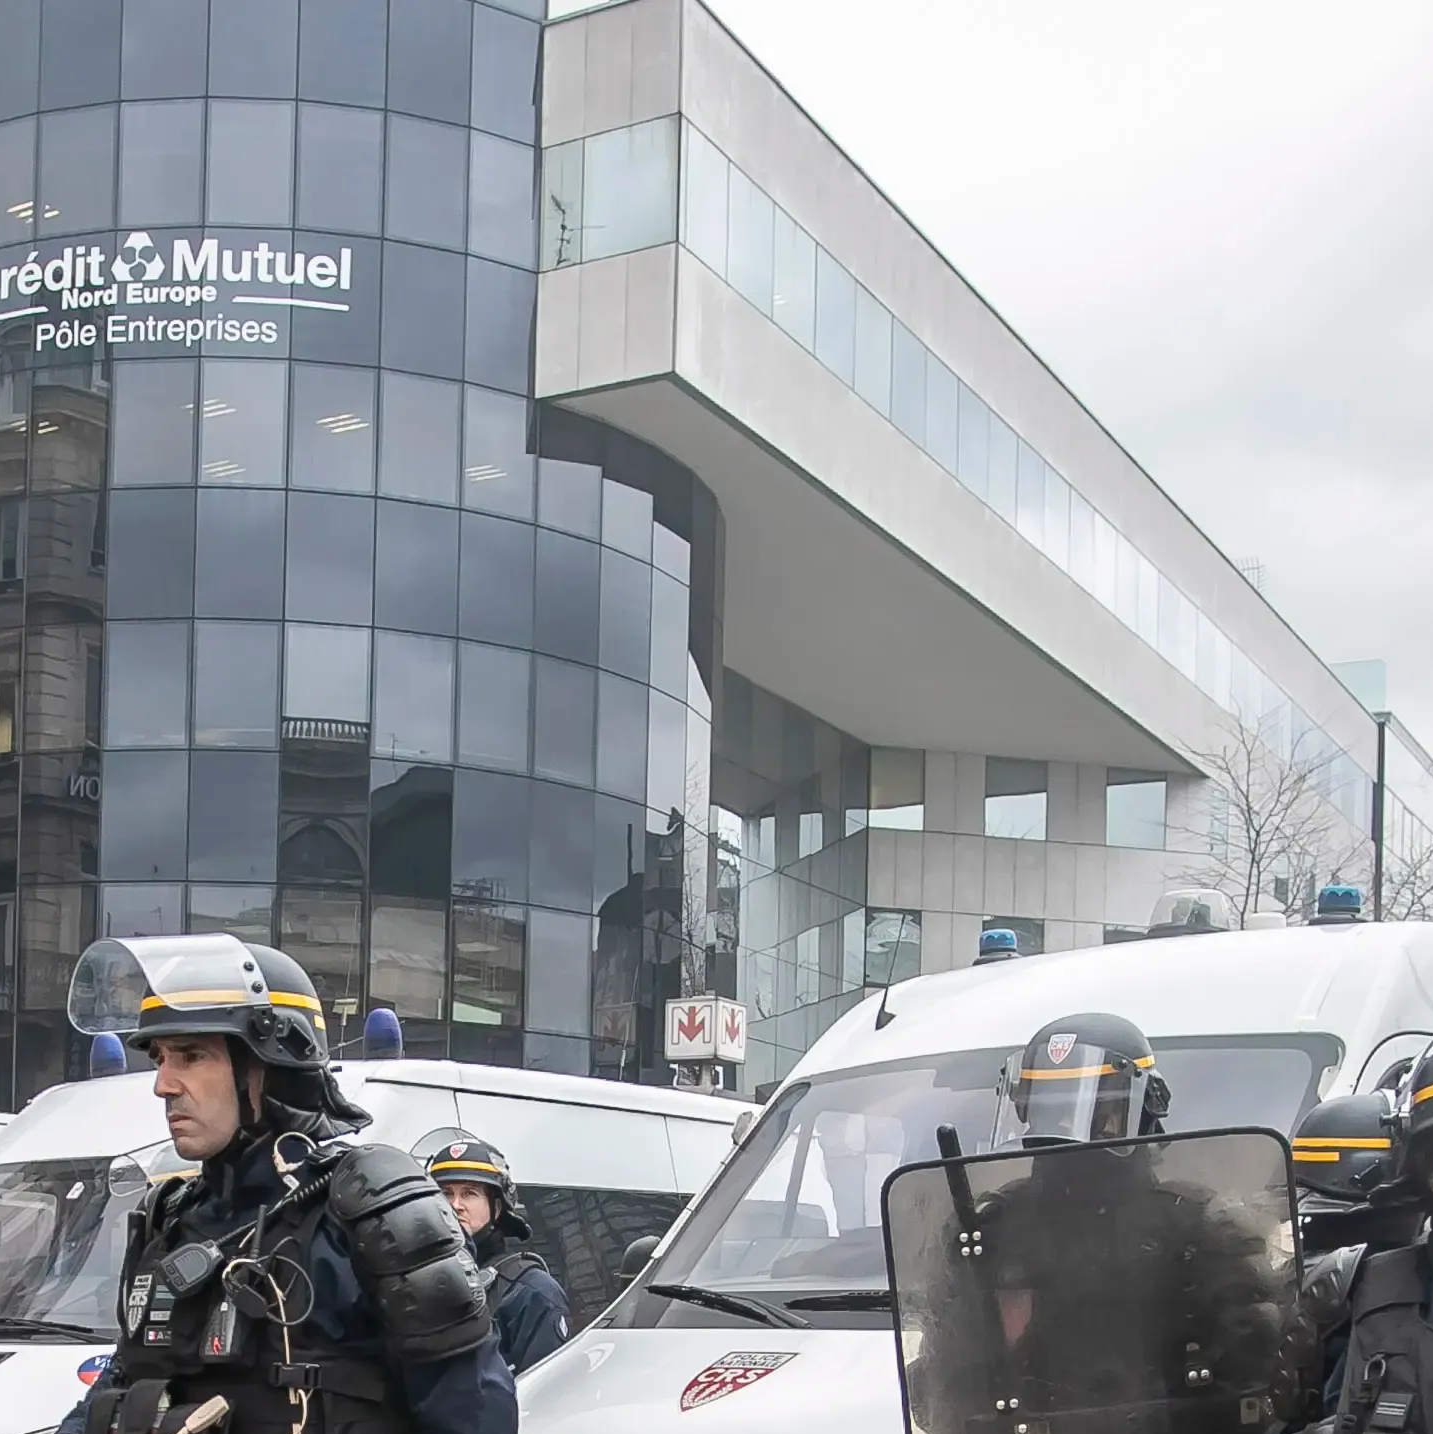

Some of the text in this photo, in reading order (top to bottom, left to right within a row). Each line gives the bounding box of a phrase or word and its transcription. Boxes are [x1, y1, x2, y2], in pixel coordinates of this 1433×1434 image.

[172, 238, 352, 290] Mutuel
[61, 283, 218, 310] Nord Europe
[35, 313, 278, 352] Pôle Entreprises
[697, 1368, 766, 1384] CRS
